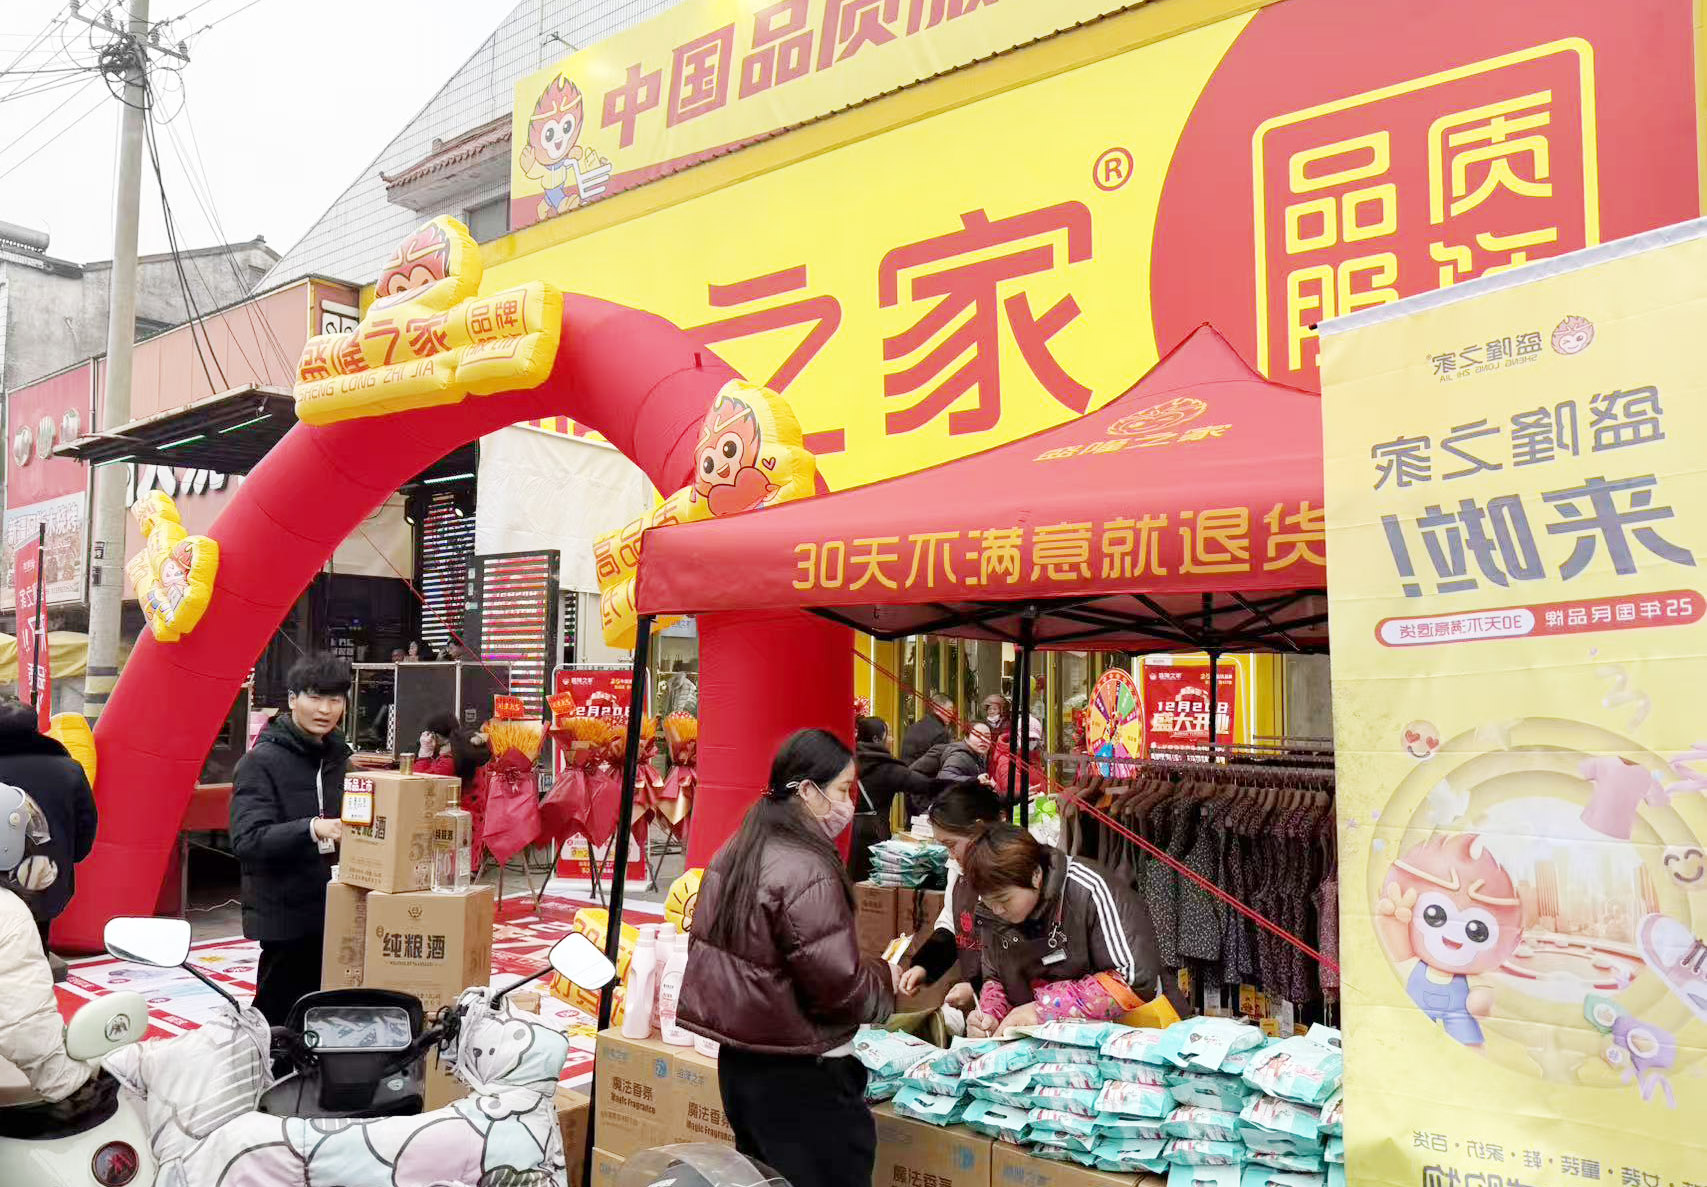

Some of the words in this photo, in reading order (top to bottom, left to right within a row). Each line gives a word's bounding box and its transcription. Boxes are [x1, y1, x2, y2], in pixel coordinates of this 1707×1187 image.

[1285, 89, 1553, 256] 品质
[471, 300, 518, 335] 品牌
[341, 375, 376, 393] LONG
[383, 367, 404, 383] ZHI
[411, 360, 434, 378] JIA
[792, 500, 1326, 592] 30天不满意就退货
[382, 932, 446, 960] 纯粮酒
